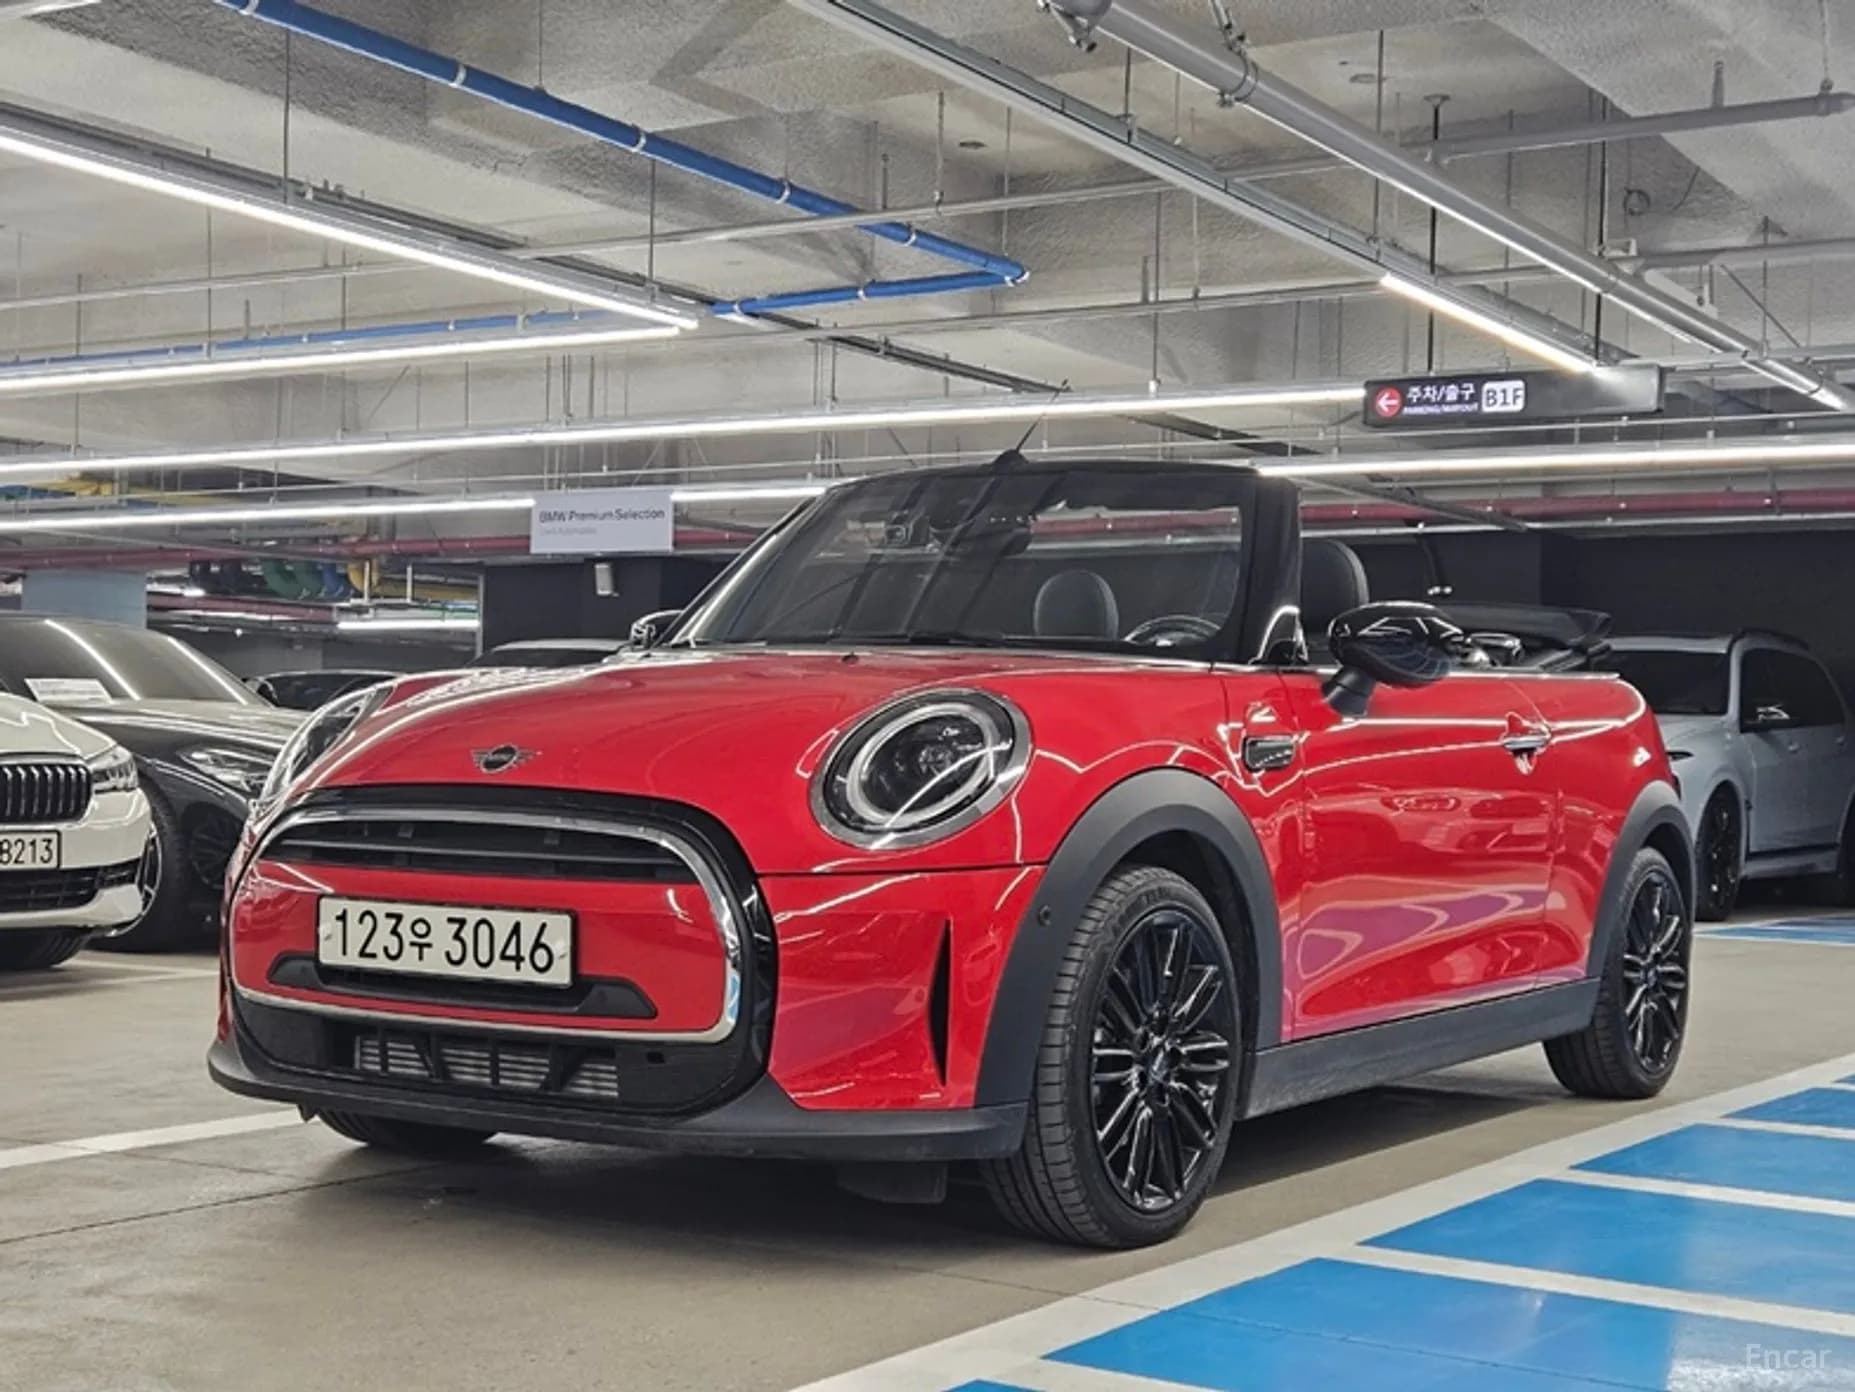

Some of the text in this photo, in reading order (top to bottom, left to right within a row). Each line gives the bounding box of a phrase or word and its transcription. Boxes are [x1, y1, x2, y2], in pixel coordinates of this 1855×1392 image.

[1485, 388, 1524, 408] B1F
[539, 508, 665, 523] BMW Premium Selection
[0, 838, 53, 864] 8213
[335, 908, 554, 974] 123우 3046
